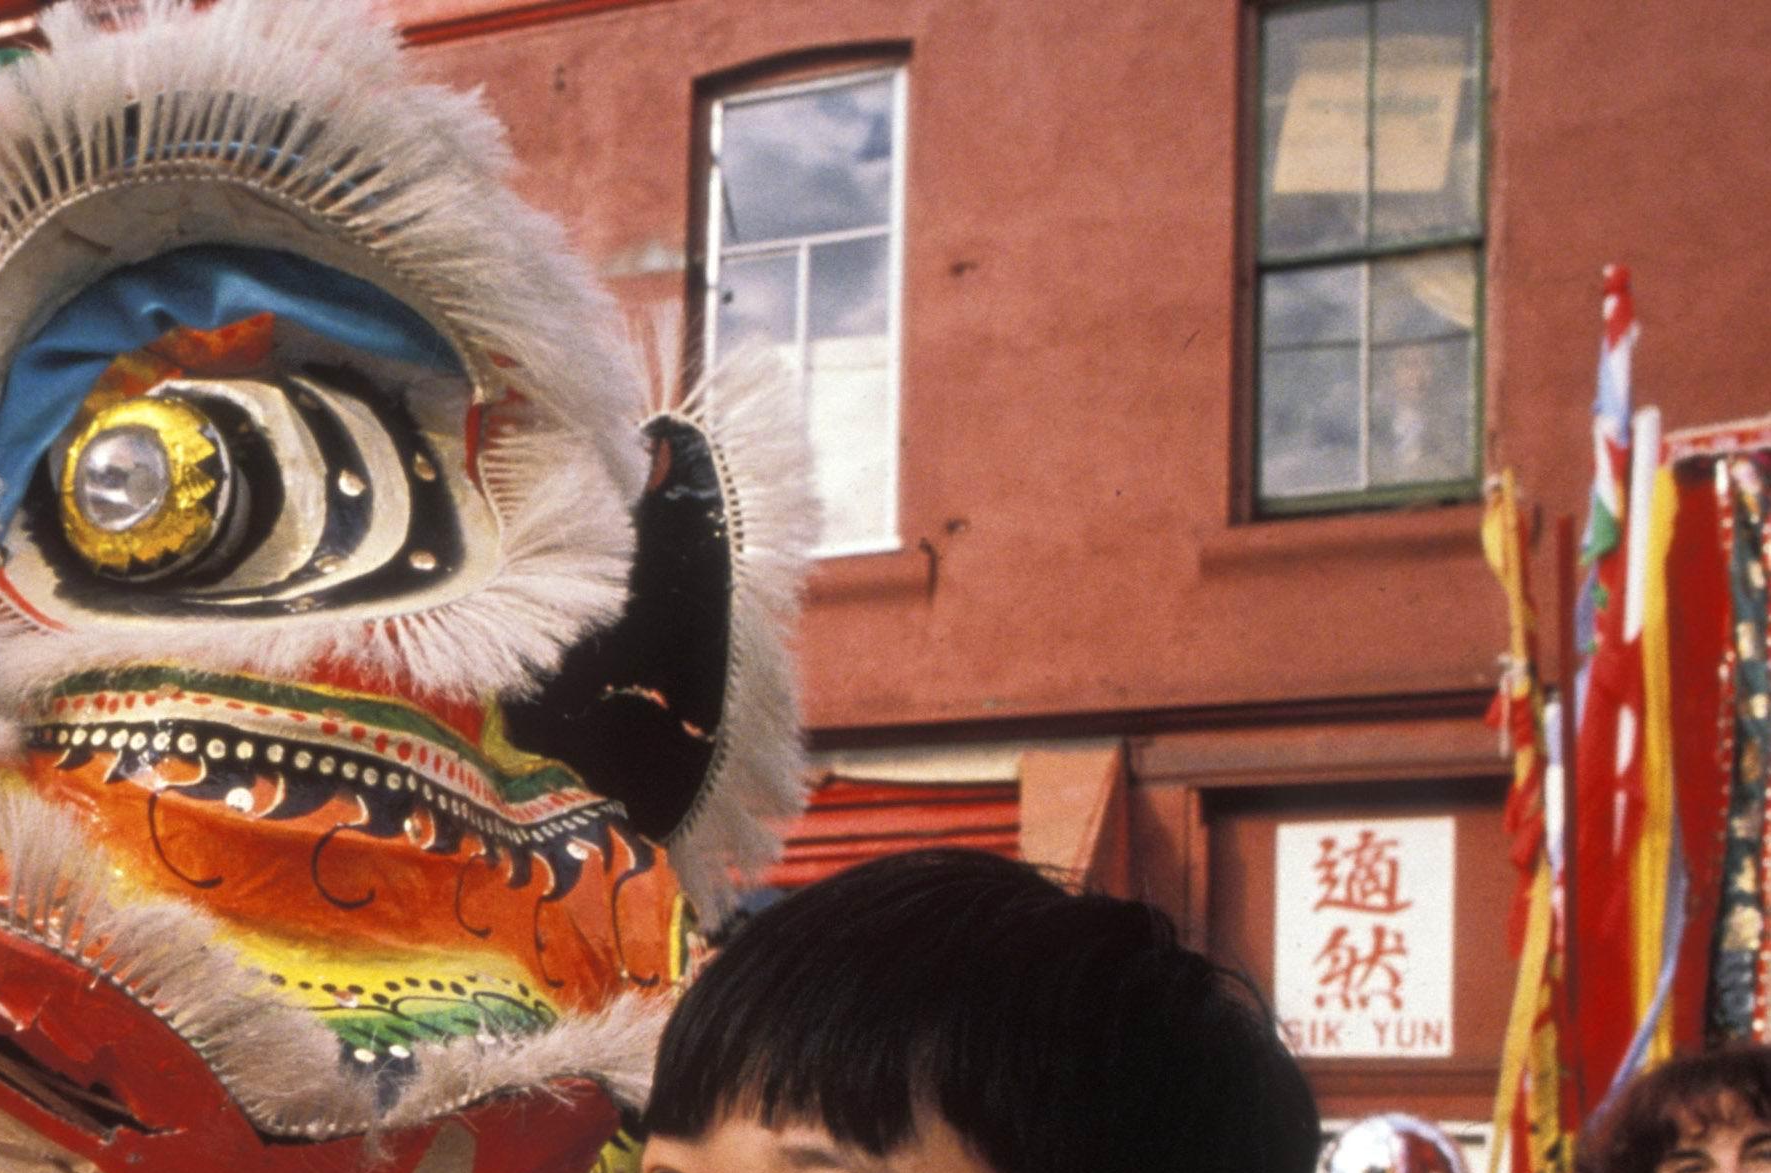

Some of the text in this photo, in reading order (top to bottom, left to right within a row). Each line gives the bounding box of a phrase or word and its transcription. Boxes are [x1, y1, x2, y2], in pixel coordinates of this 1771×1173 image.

[1313, 830, 1413, 1010] 適然
[1283, 1018, 1443, 1048] SIK YUN
